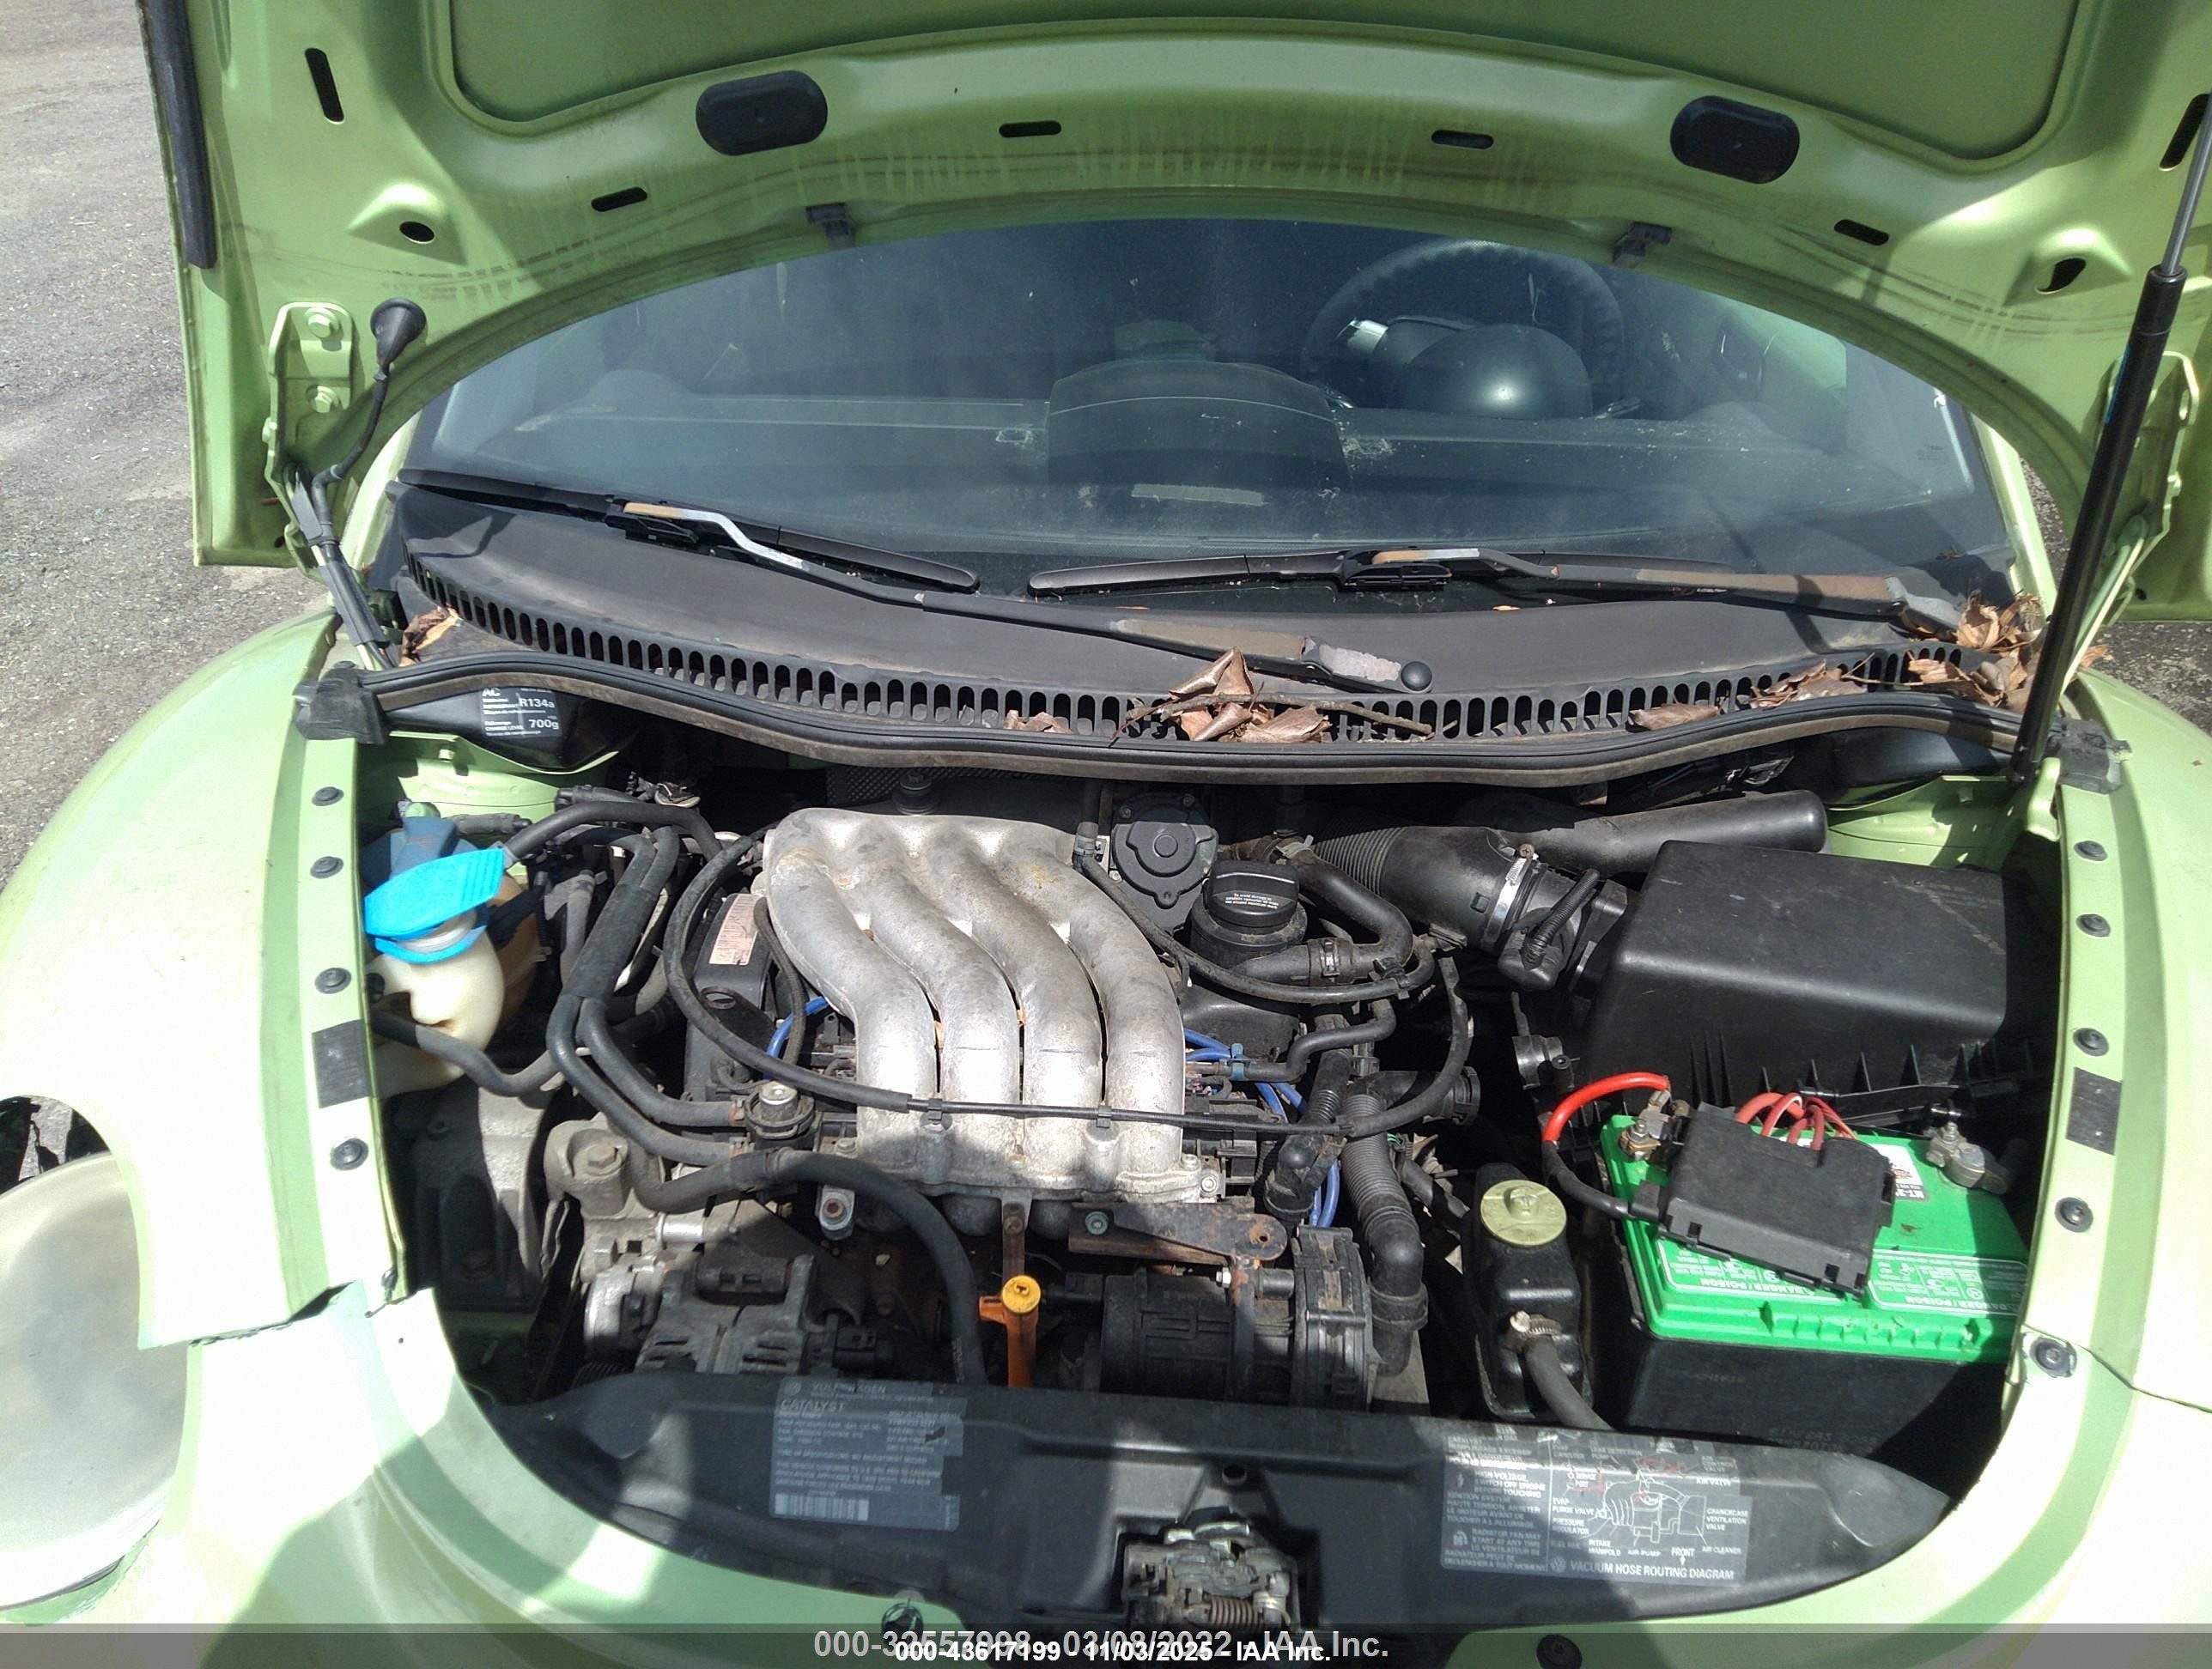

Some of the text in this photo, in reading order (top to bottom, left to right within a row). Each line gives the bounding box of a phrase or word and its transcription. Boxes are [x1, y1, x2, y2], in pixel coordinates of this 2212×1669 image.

[519, 698, 556, 708] R134a
[529, 719, 559, 730] 700g
[780, 1399, 847, 1411] CATALYST
[1494, 1472, 1528, 1481] VOLTAGE
[1518, 1482, 1546, 1491] ENGINE
[1504, 1489, 1541, 1498] TOUCHING
[1552, 1506, 1574, 1514] PURGE
[1553, 1518, 1585, 1526] PRESSURE
[1705, 1516, 1747, 1525] VENTILATION
[1553, 1526, 1589, 1535] REGULATOR
[1705, 1523, 1726, 1532] VALVE
[1589, 1539, 1611, 1548] INTAKE
[1589, 1548, 1621, 1557] MANIFOLD
[1671, 1547, 1695, 1557] FRONT
[1712, 1547, 1741, 1556] CLEANER
[1571, 1559, 1735, 1580] VACUUM HOSE ROUTING DIAGRAM
